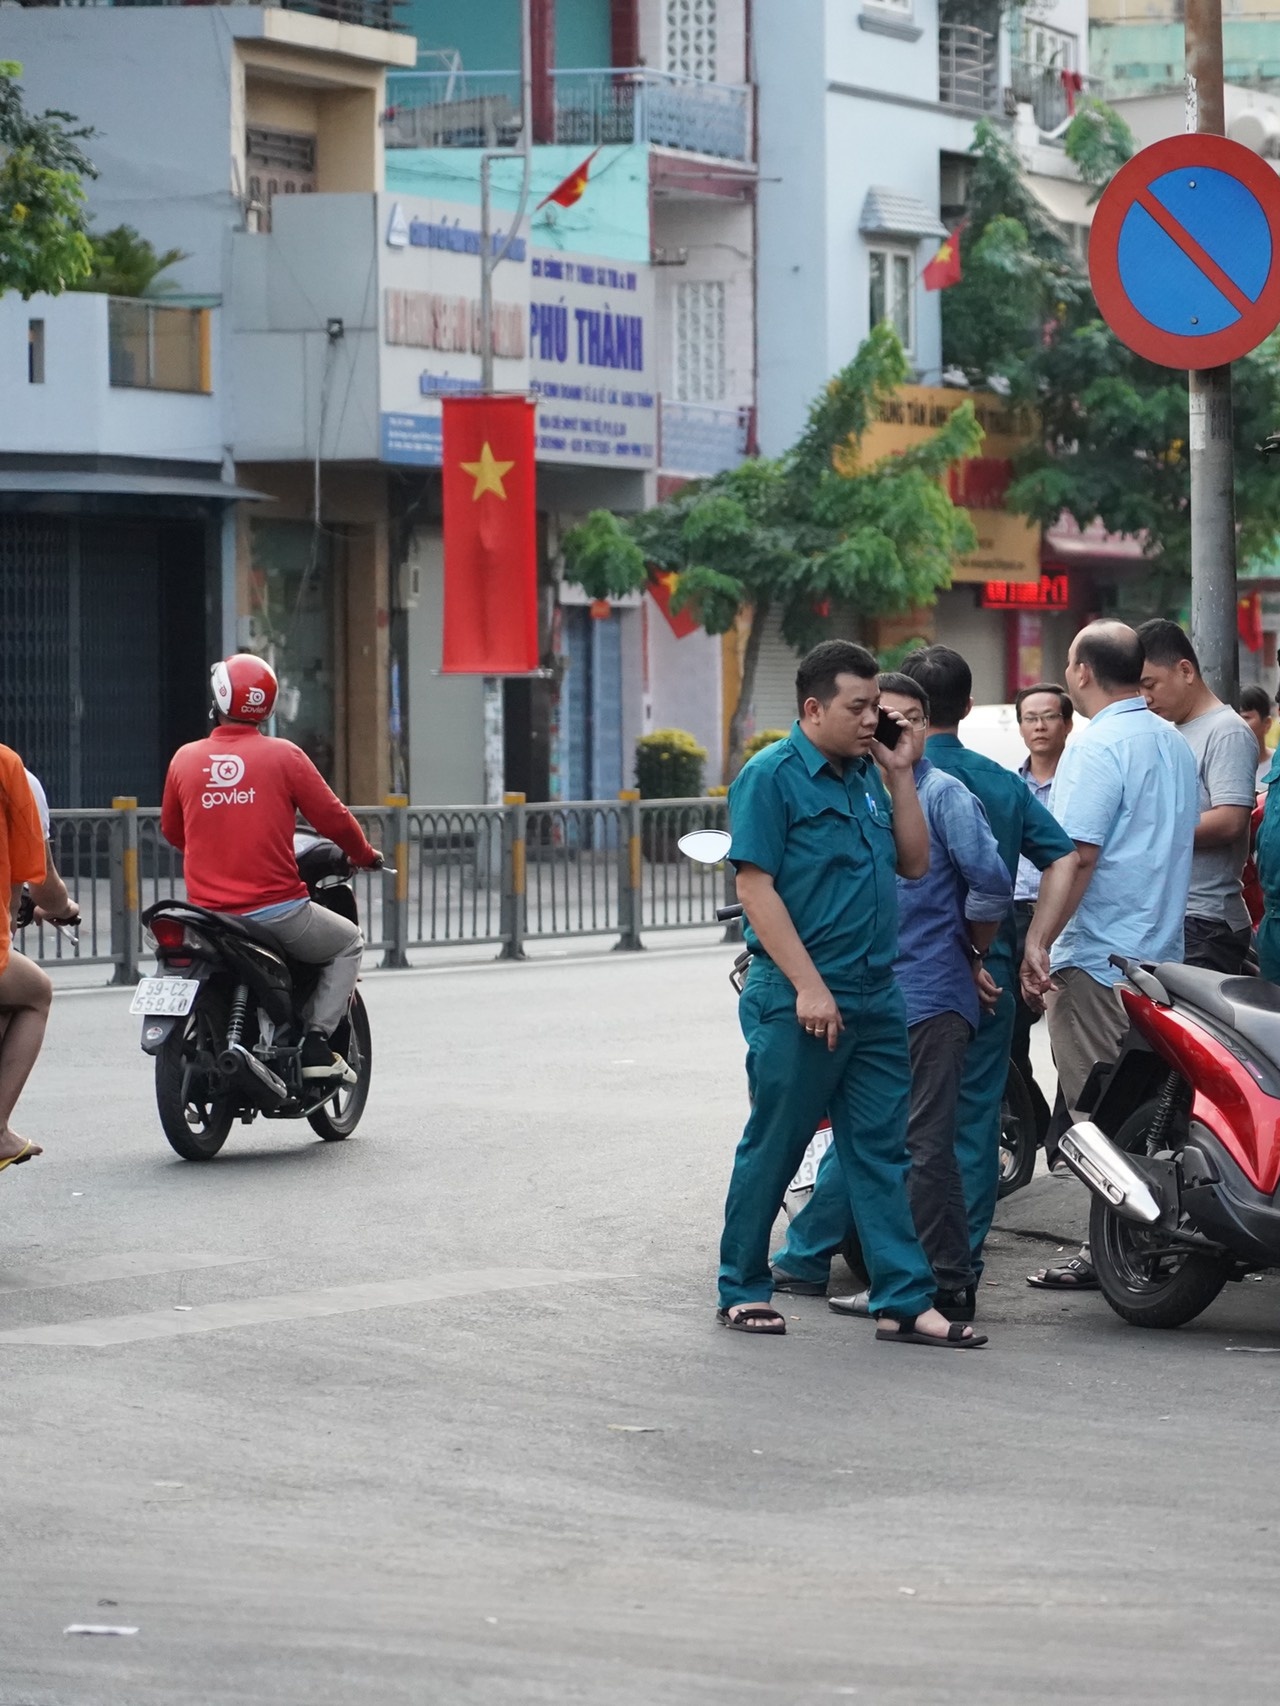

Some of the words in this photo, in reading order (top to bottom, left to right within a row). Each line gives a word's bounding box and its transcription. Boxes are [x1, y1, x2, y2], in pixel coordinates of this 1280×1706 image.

[530, 296, 568, 363] PHÚ
[574, 302, 643, 372] THÀNH
[201, 787, 257, 809] goviet
[145, 981, 189, 997] 59-C2
